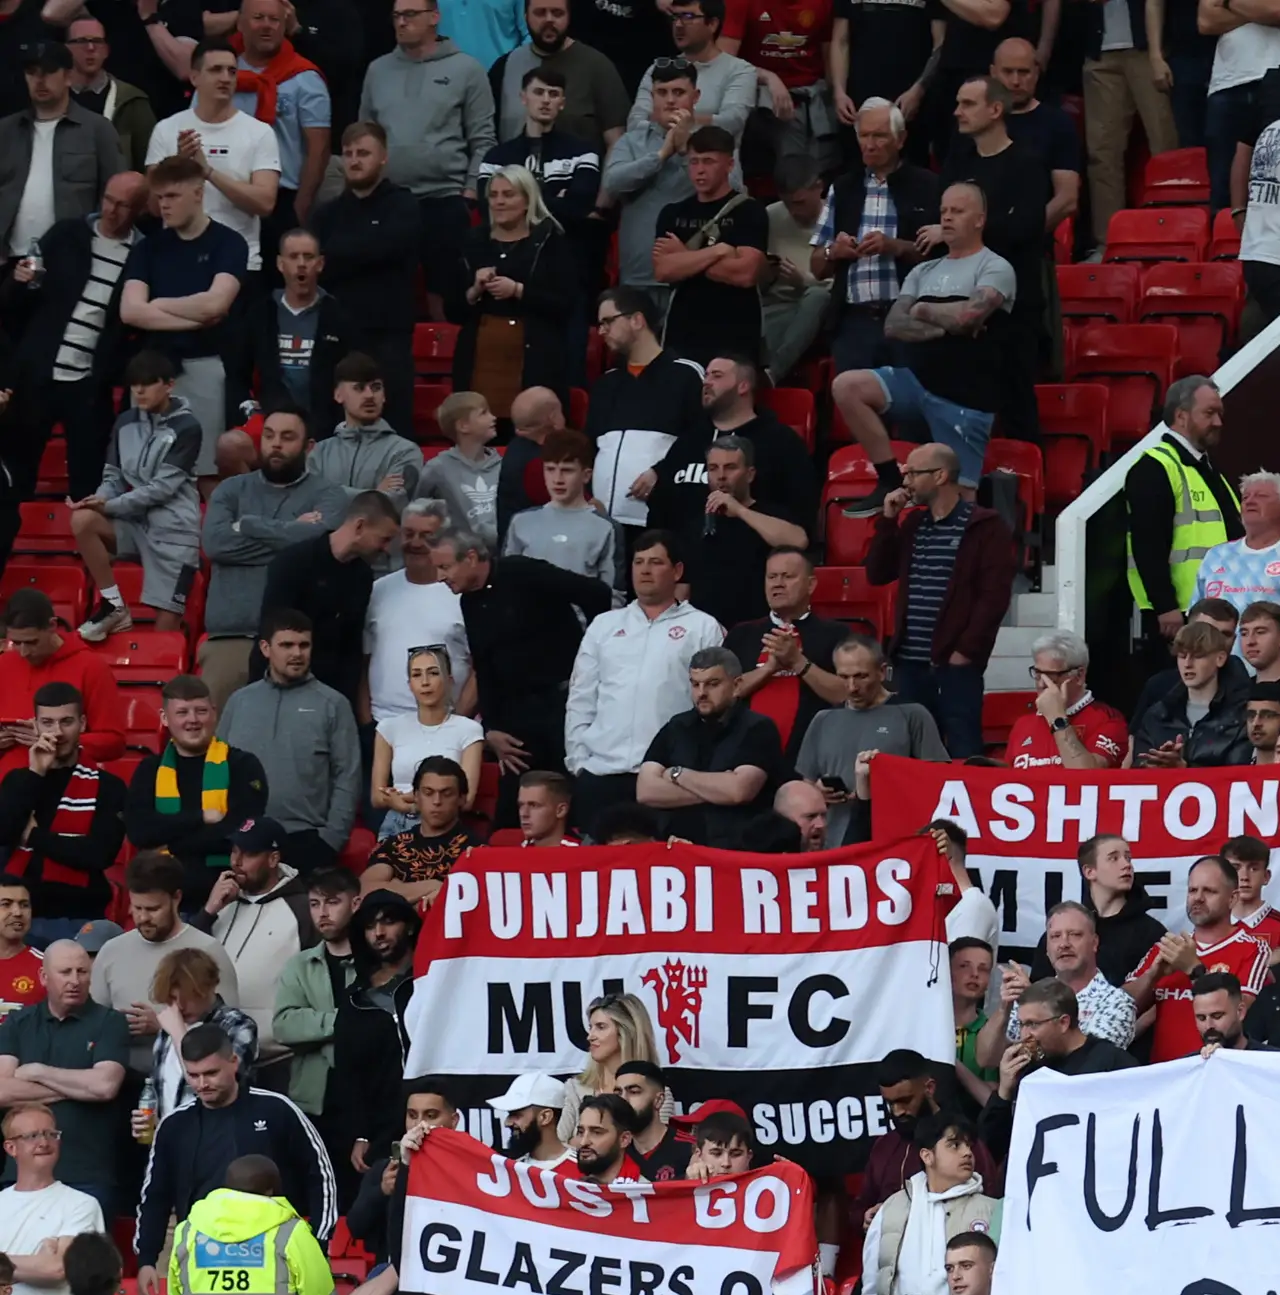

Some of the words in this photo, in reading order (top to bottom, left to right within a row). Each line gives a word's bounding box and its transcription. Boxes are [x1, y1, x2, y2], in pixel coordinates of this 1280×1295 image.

[930, 780, 1280, 845] ASHTON
[443, 865, 714, 941] PUNJABI
[741, 857, 914, 936] REDS
[726, 973, 851, 1050] FC
[1154, 987, 1194, 1002] SHA
[753, 1095, 896, 1146] SUCCE
[476, 1153, 656, 1224] JUST
[693, 1174, 790, 1234] GO
[225, 1243, 265, 1258] CSG
[207, 1269, 251, 1291] 758
